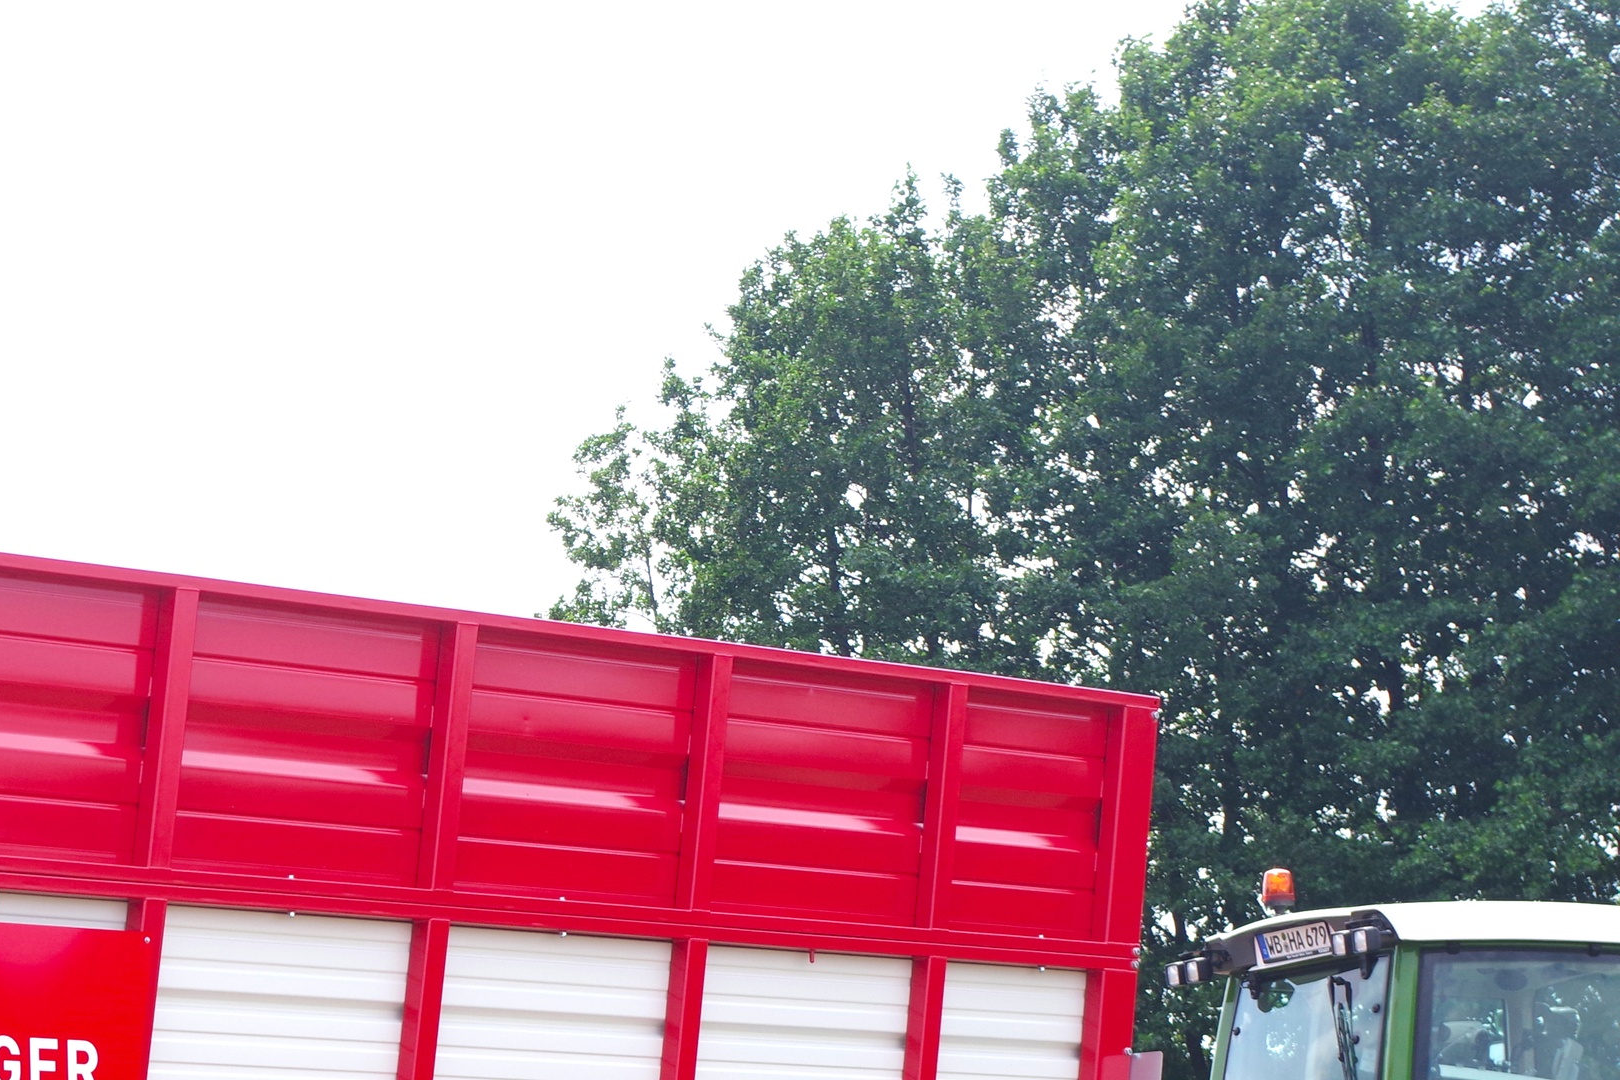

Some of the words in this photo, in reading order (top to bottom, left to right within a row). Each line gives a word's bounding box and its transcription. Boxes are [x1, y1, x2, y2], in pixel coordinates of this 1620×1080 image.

[1265, 935, 1283, 955] WB
[1286, 930, 1305, 952] HA
[1306, 925, 1327, 947] 679
